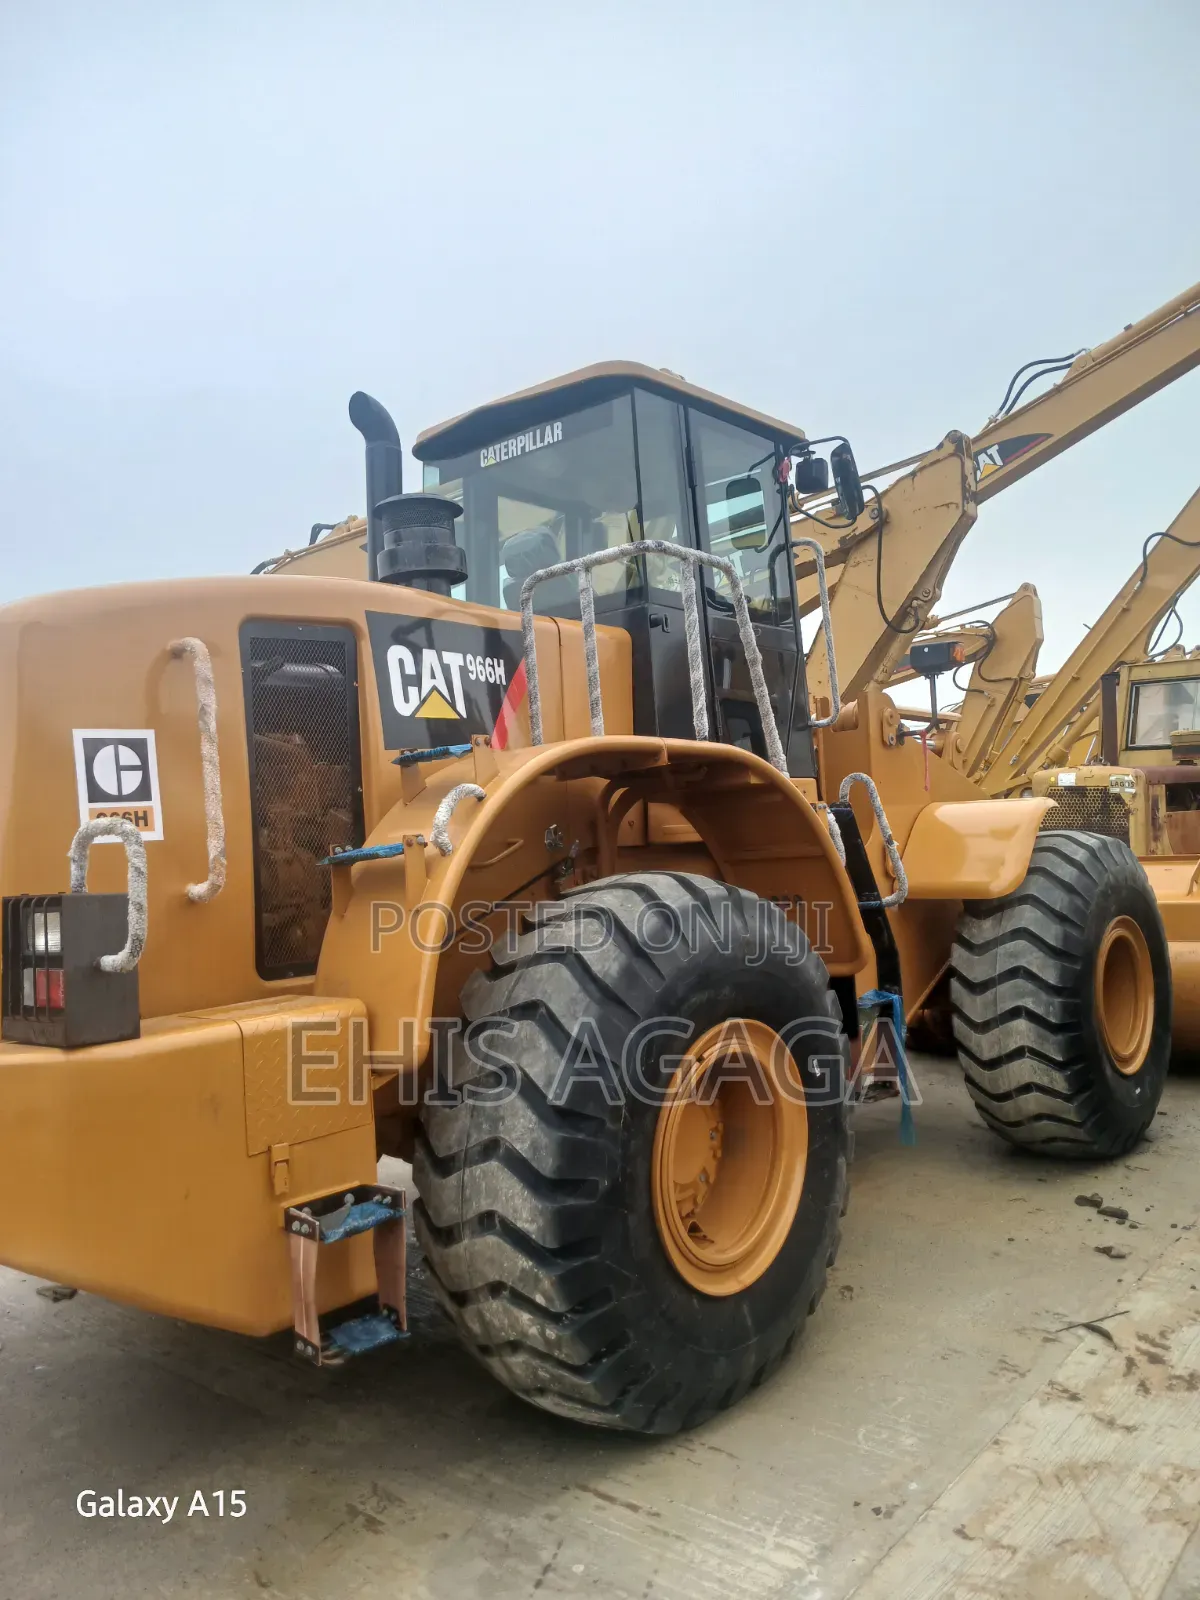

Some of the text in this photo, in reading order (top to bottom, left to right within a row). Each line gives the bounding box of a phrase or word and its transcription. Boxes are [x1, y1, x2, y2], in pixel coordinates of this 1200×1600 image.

[480, 421, 563, 468] CATERPILLAR
[974, 444, 1004, 482] AT
[386, 644, 507, 719] CAT 966H
